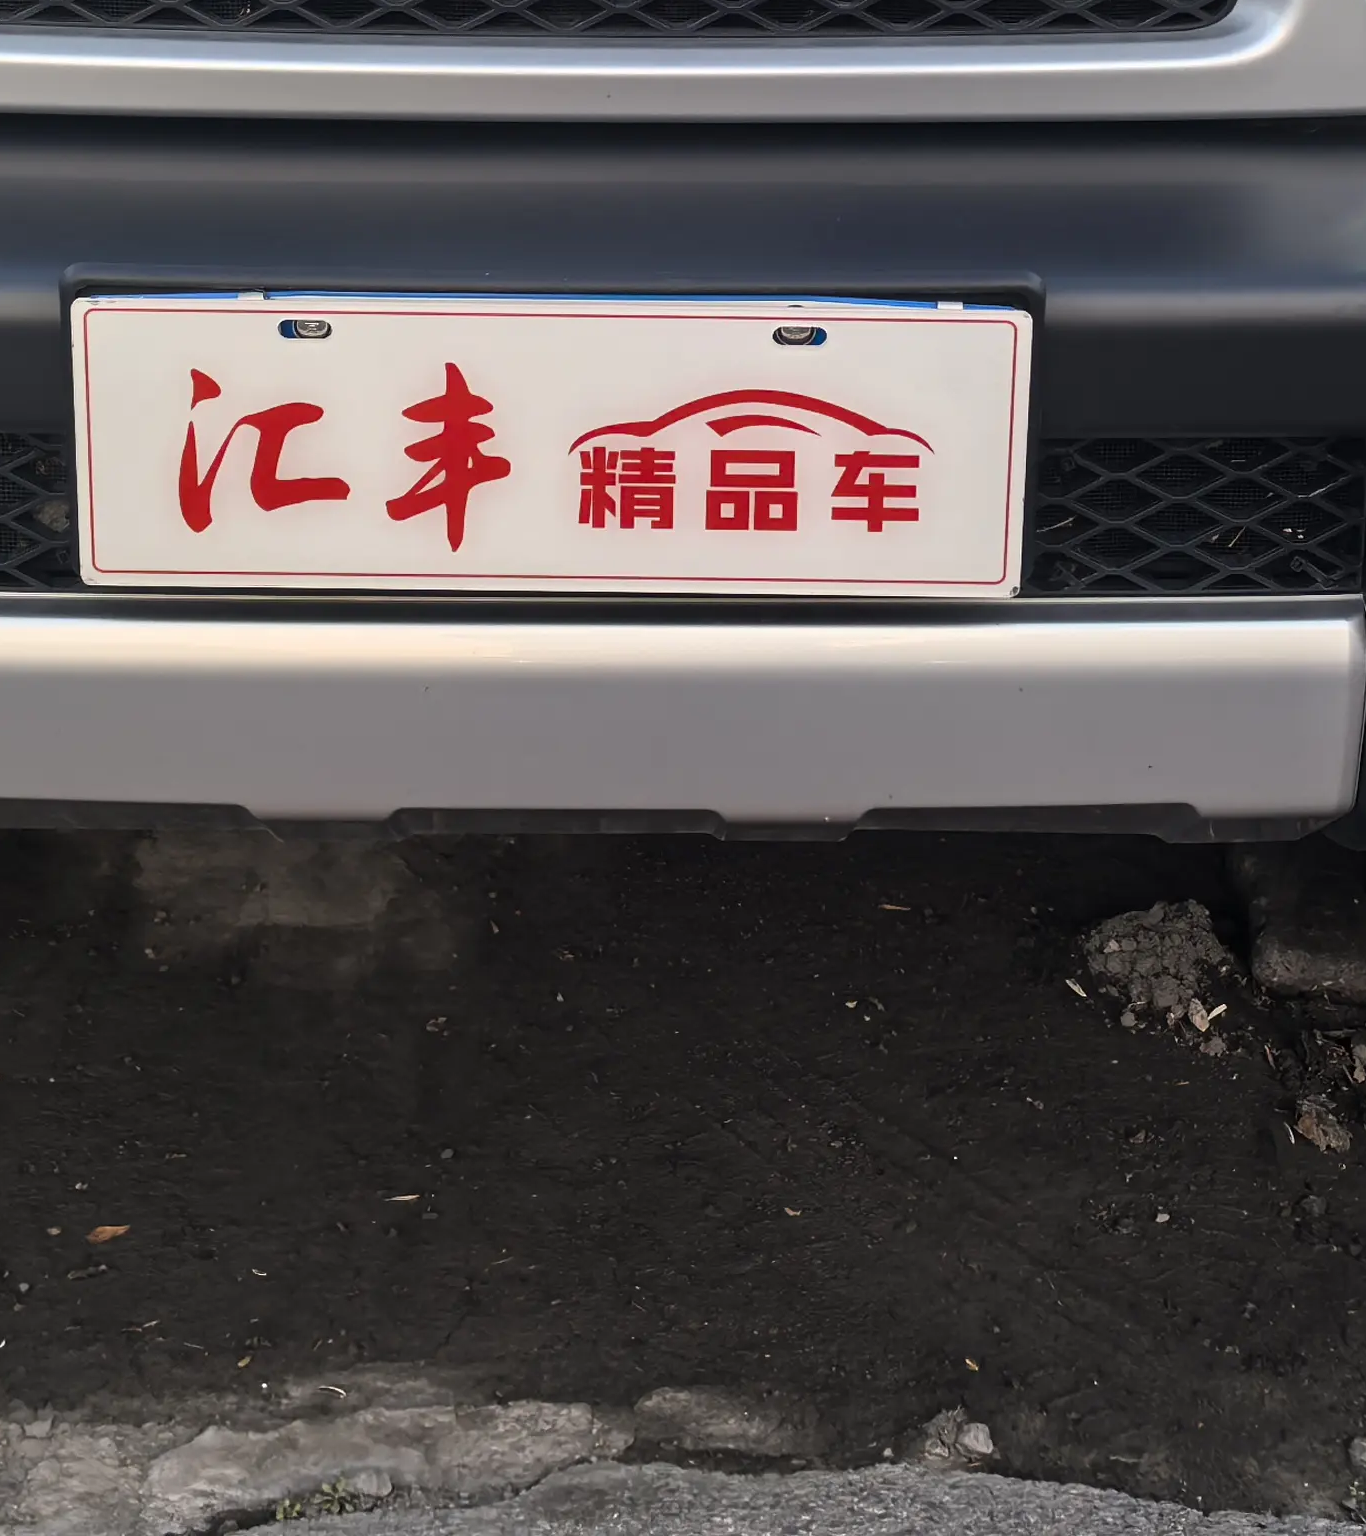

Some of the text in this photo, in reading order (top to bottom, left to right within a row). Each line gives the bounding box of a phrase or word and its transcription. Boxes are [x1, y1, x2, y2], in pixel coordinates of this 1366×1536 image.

[179, 362, 922, 553] 汇丰 精品车
